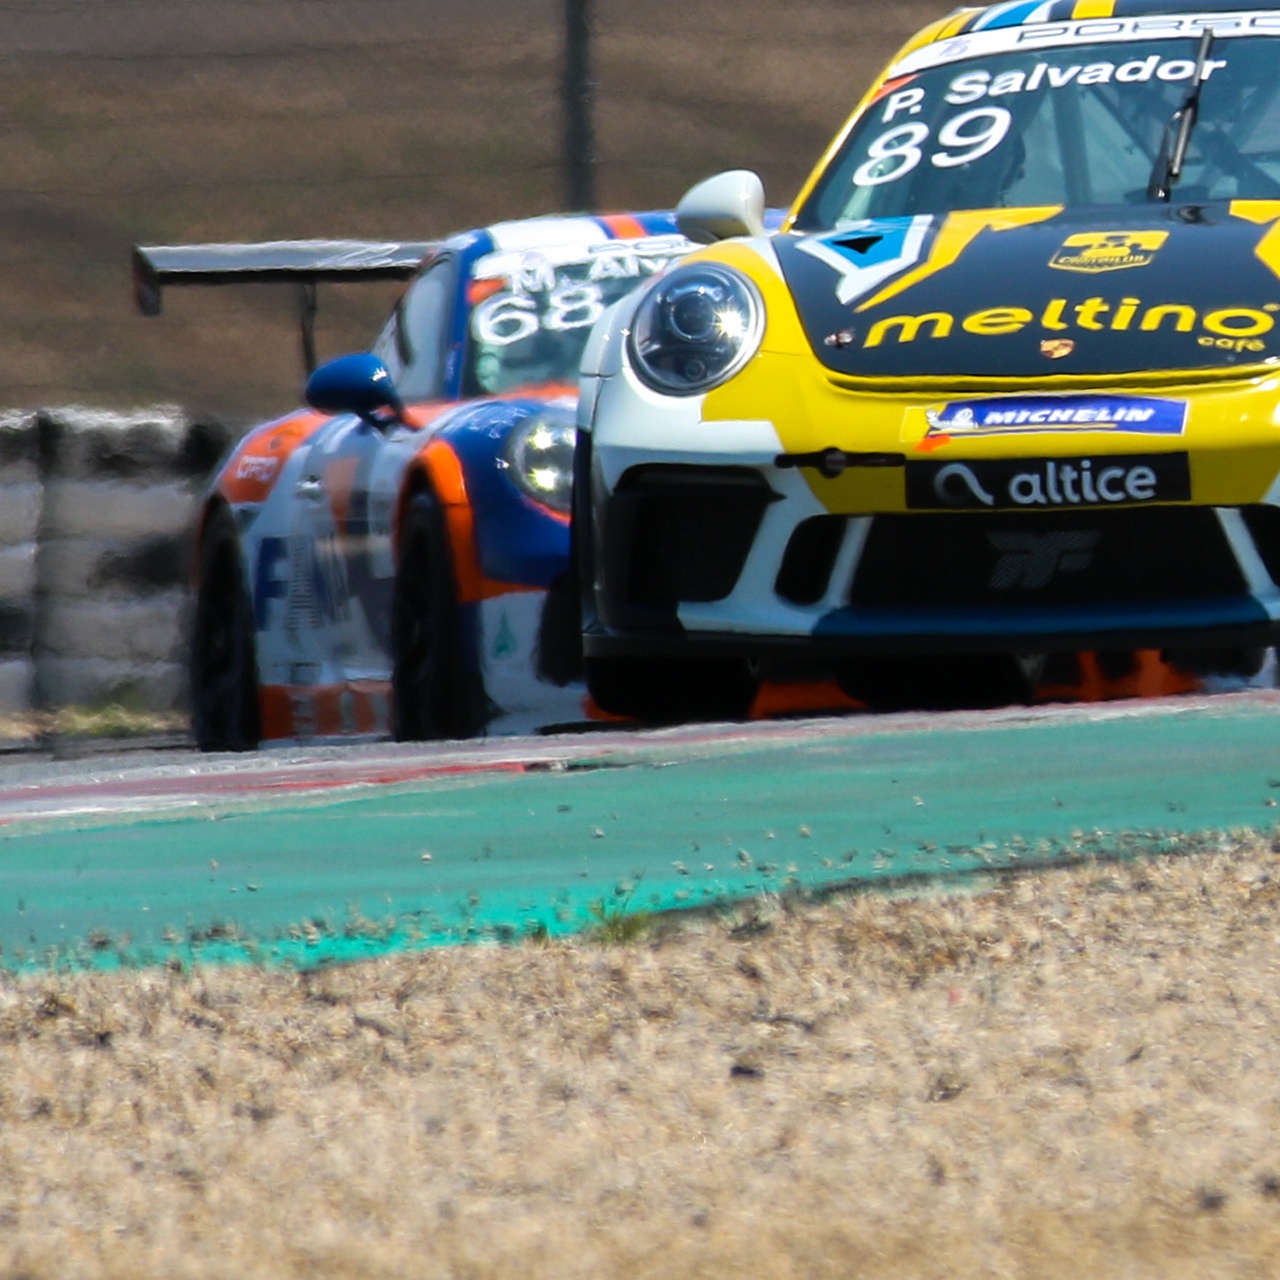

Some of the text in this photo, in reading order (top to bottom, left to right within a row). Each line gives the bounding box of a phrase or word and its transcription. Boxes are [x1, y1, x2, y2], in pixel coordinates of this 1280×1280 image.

[882, 55, 1227, 123] P. Salvador
[852, 105, 1012, 187] 89
[472, 280, 605, 346] 68
[863, 296, 1276, 348] meltino
[1196, 336, 1266, 353] café
[983, 407, 1157, 425] MICHELIN
[1008, 459, 1158, 505] altice
